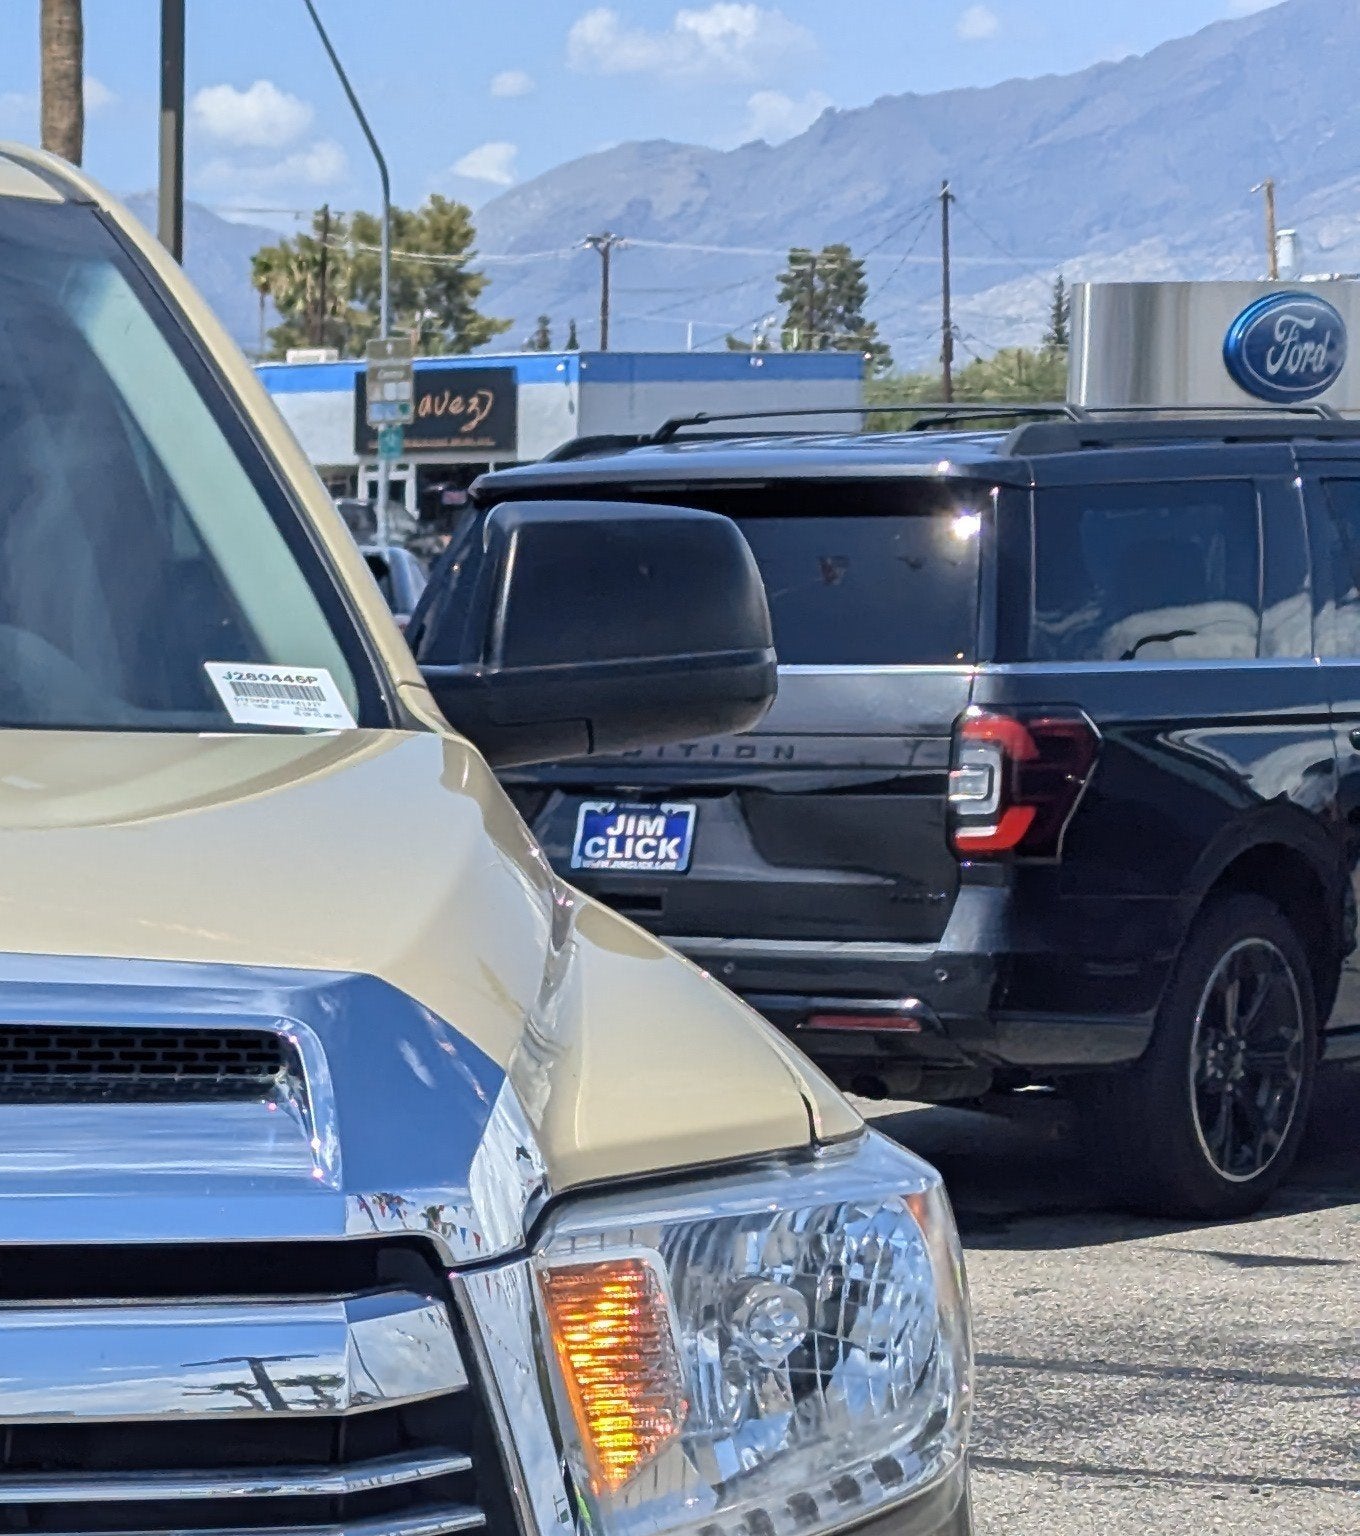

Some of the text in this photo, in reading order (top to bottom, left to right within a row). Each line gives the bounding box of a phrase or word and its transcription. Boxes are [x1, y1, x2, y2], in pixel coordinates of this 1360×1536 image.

[1266, 314, 1331, 375] Ford
[417, 389, 495, 432] avez
[606, 813, 667, 837] JIM
[583, 836, 682, 861] CLICK
